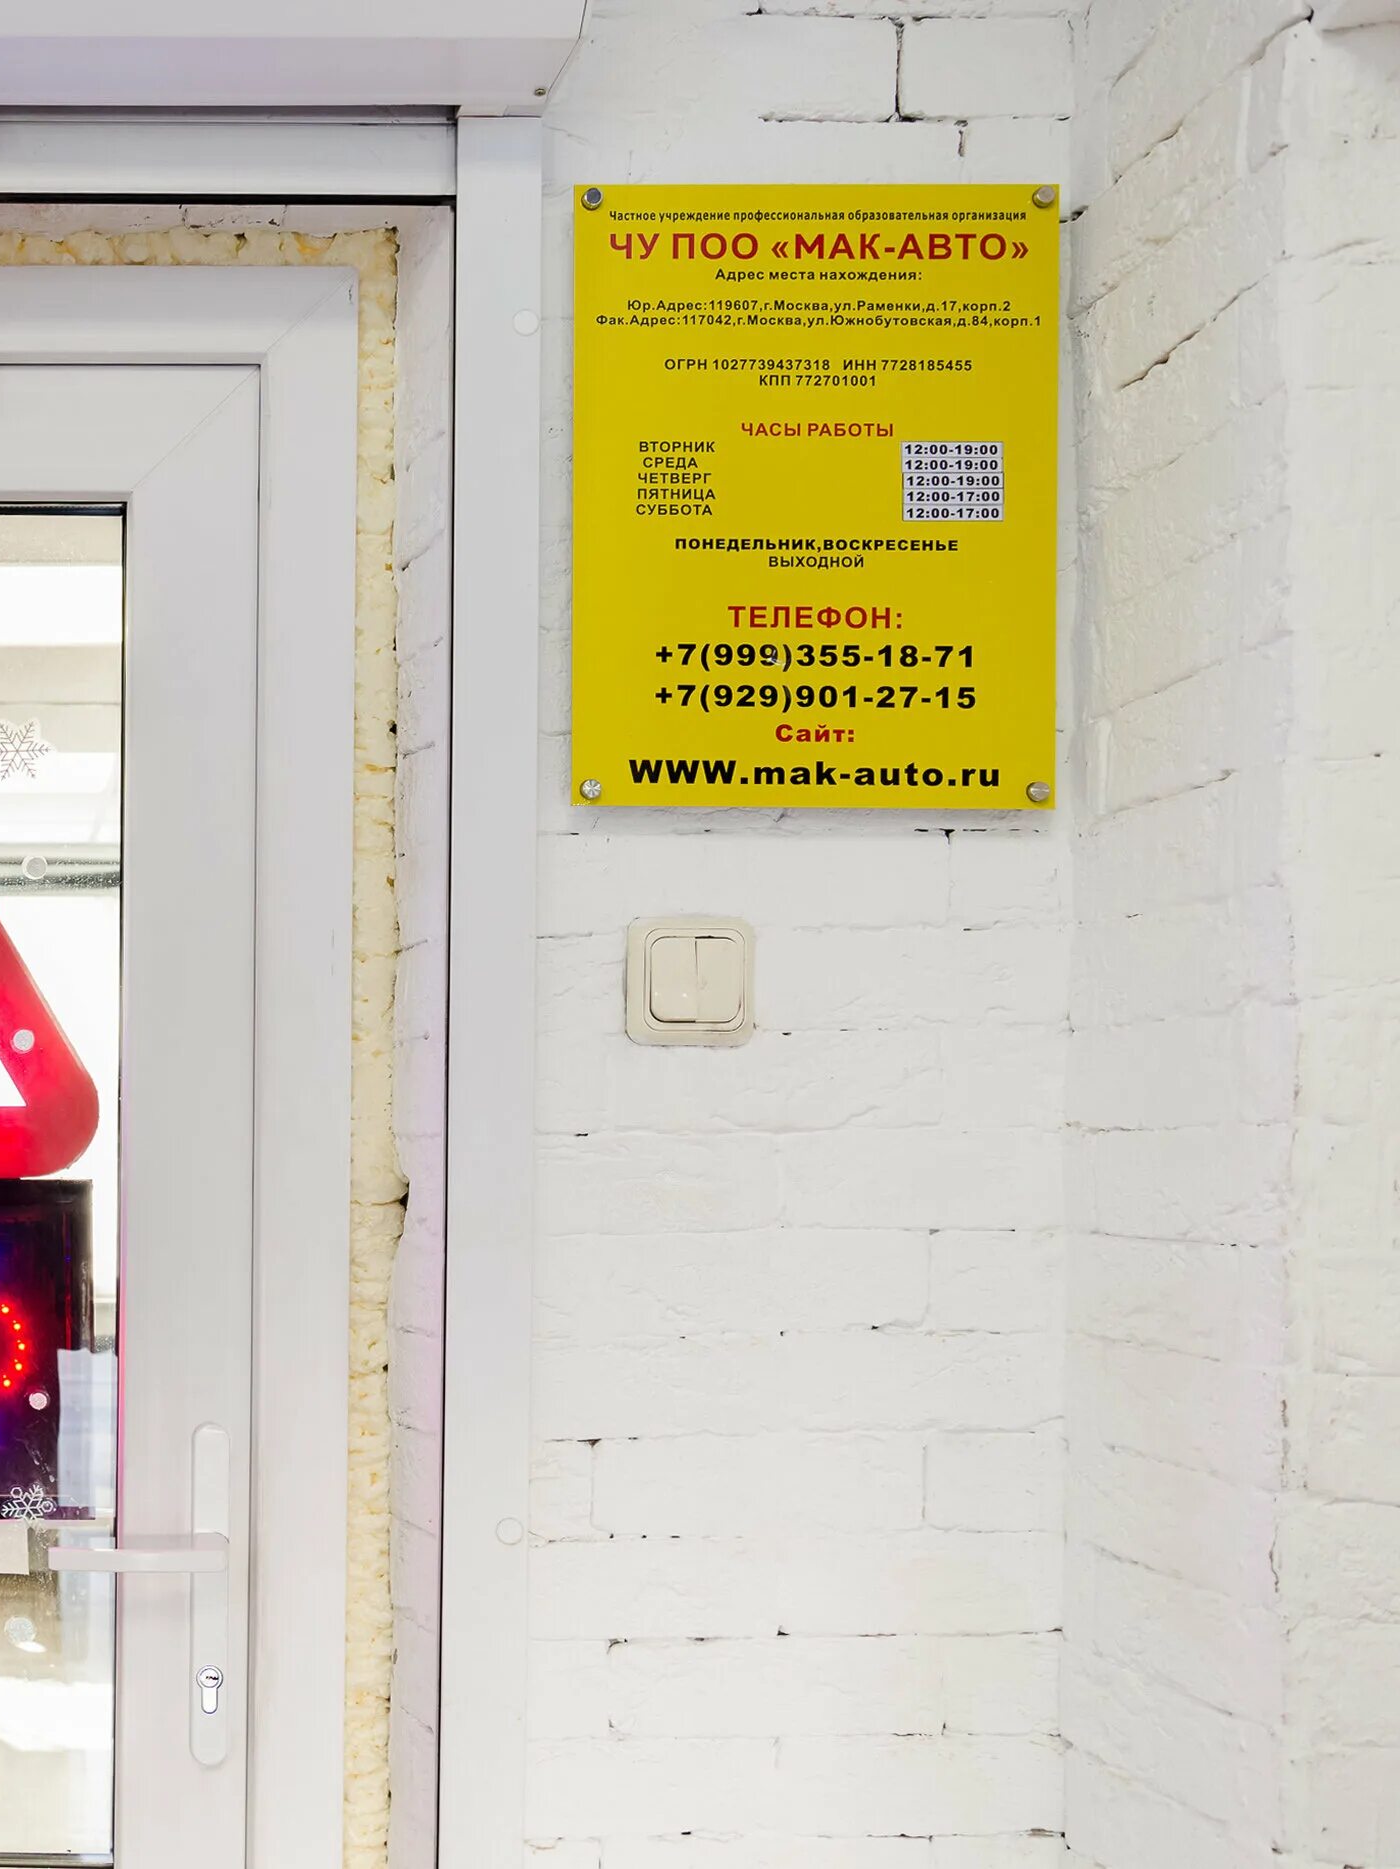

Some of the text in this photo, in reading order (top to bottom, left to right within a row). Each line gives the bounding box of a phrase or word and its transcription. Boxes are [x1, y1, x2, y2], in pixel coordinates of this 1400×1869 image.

[609, 209, 1027, 222] Частное учреждение профессиональная образовательная организация
[609, 232, 1030, 261] ЧУ ПОО «МАК-АВТО»
[715, 268, 922, 282] Адрес места нахождения:
[664, 358, 973, 372] ОГРН 1027739437318 ИНН 7728185455
[759, 374, 877, 387] КПП 772701001
[741, 422, 894, 438] ЧАСЫ РАБОТЫ
[639, 441, 998, 455] ВТОРНИК 12:00-19:00
[642, 457, 998, 470] СРЕДА 12:00-19:00
[637, 472, 1000, 486] ЧЕТВЕРГ 12:00-19:00
[637, 488, 1000, 502] ПЯТНИЦА 12:00-17:00
[635, 503, 1000, 519] СУББОТА 12:00-17:00
[768, 554, 865, 569] ВЫХОДНОЙ
[727, 605, 904, 630] ТЕЛЕФОН:
[655, 643, 974, 673] +7(999)355-18-71
[655, 684, 977, 714] +7(929)901-27-15
[775, 723, 855, 743] Сайт:
[628, 759, 1001, 788] WWW.mak-auto.ru
